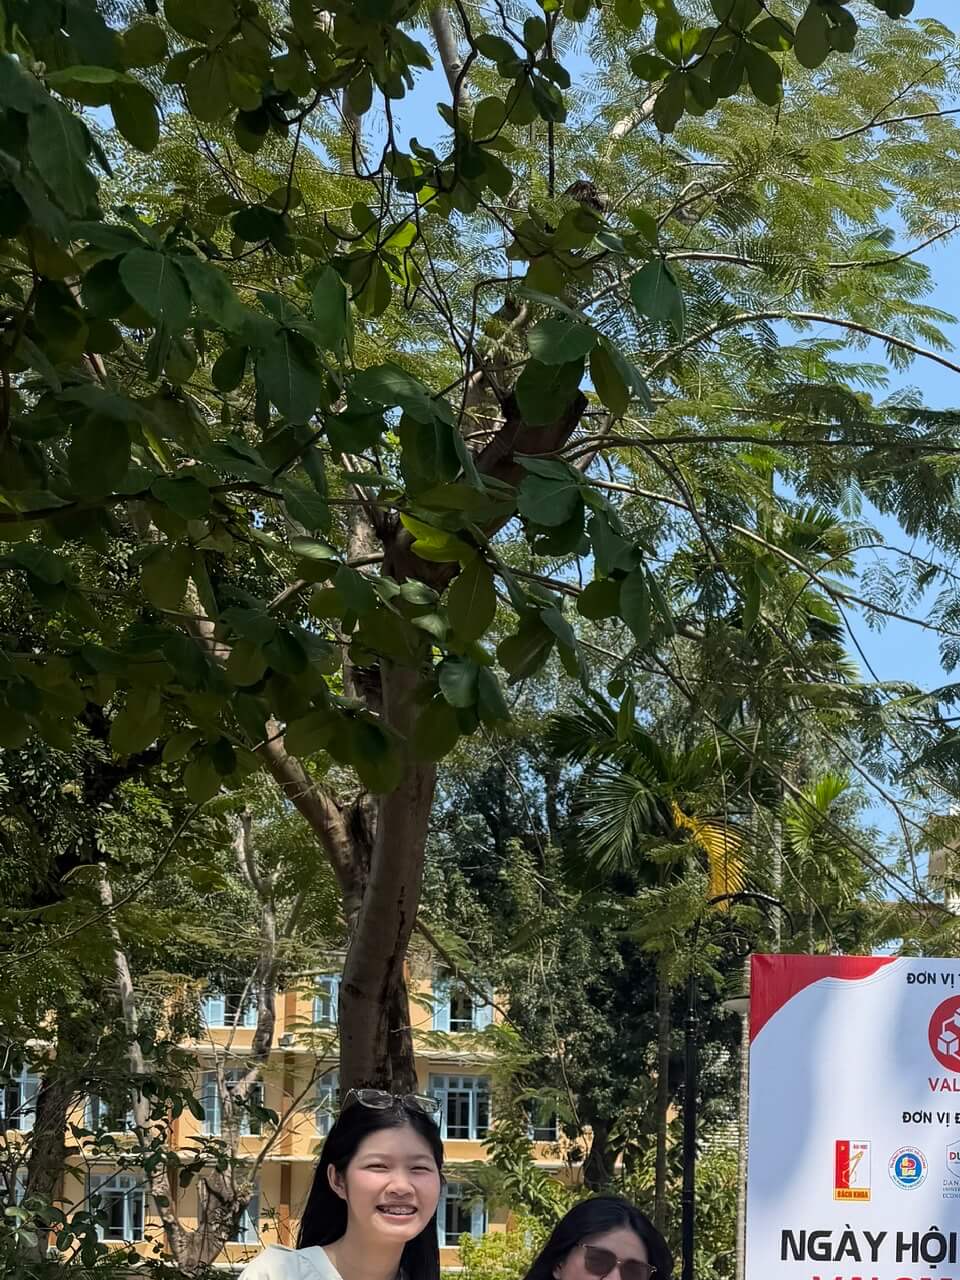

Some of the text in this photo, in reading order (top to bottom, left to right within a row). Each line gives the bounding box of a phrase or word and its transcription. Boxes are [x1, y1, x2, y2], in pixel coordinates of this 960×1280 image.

[906, 971, 937, 985] ĐƠN
[940, 973, 954, 988] VỊ
[902, 1110, 932, 1124] ĐƠN
[937, 1111, 950, 1128] VỊ
[781, 1224, 888, 1262] NGÀY
[895, 1226, 957, 1269] HỘI
